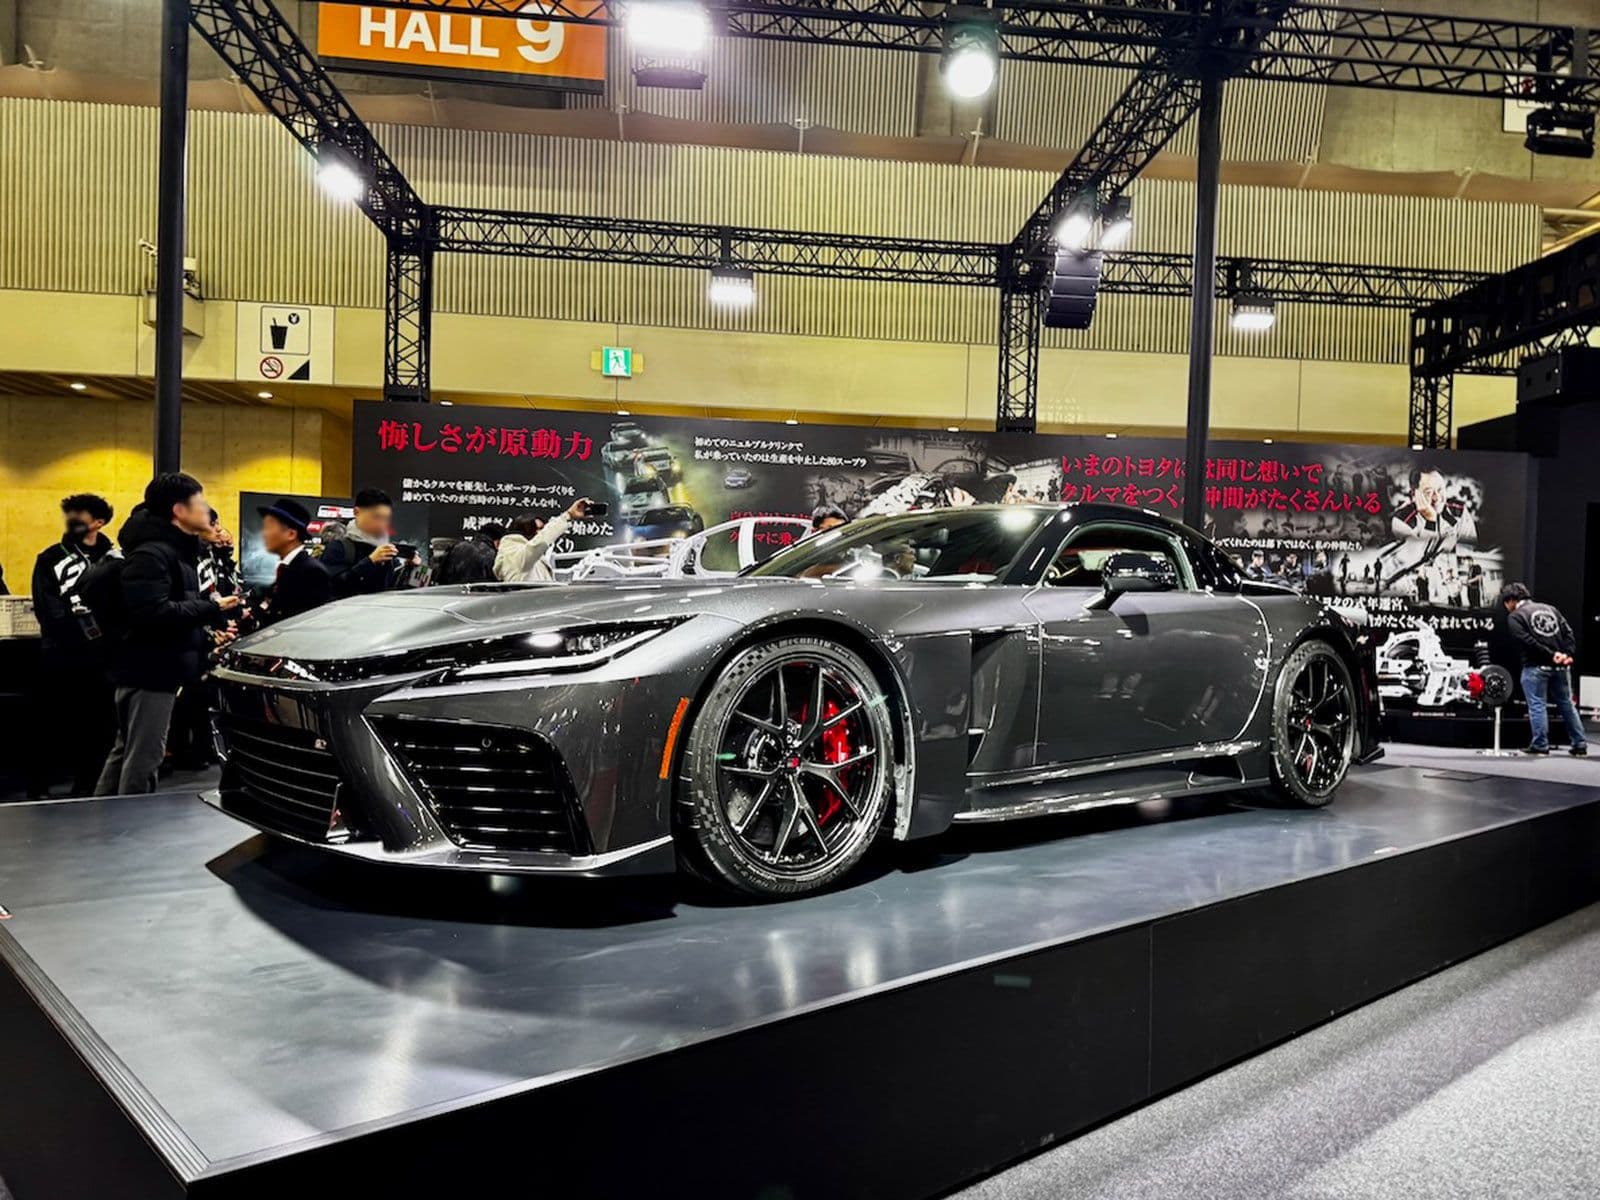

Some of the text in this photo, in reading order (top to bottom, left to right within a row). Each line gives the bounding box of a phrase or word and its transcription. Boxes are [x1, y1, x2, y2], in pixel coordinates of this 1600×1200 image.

[359, 2, 565, 64] HALL 9
[377, 419, 593, 461] 悔しさが原動力
[1060, 482, 1382, 514] クルマをつく仲間がたくさんいる
